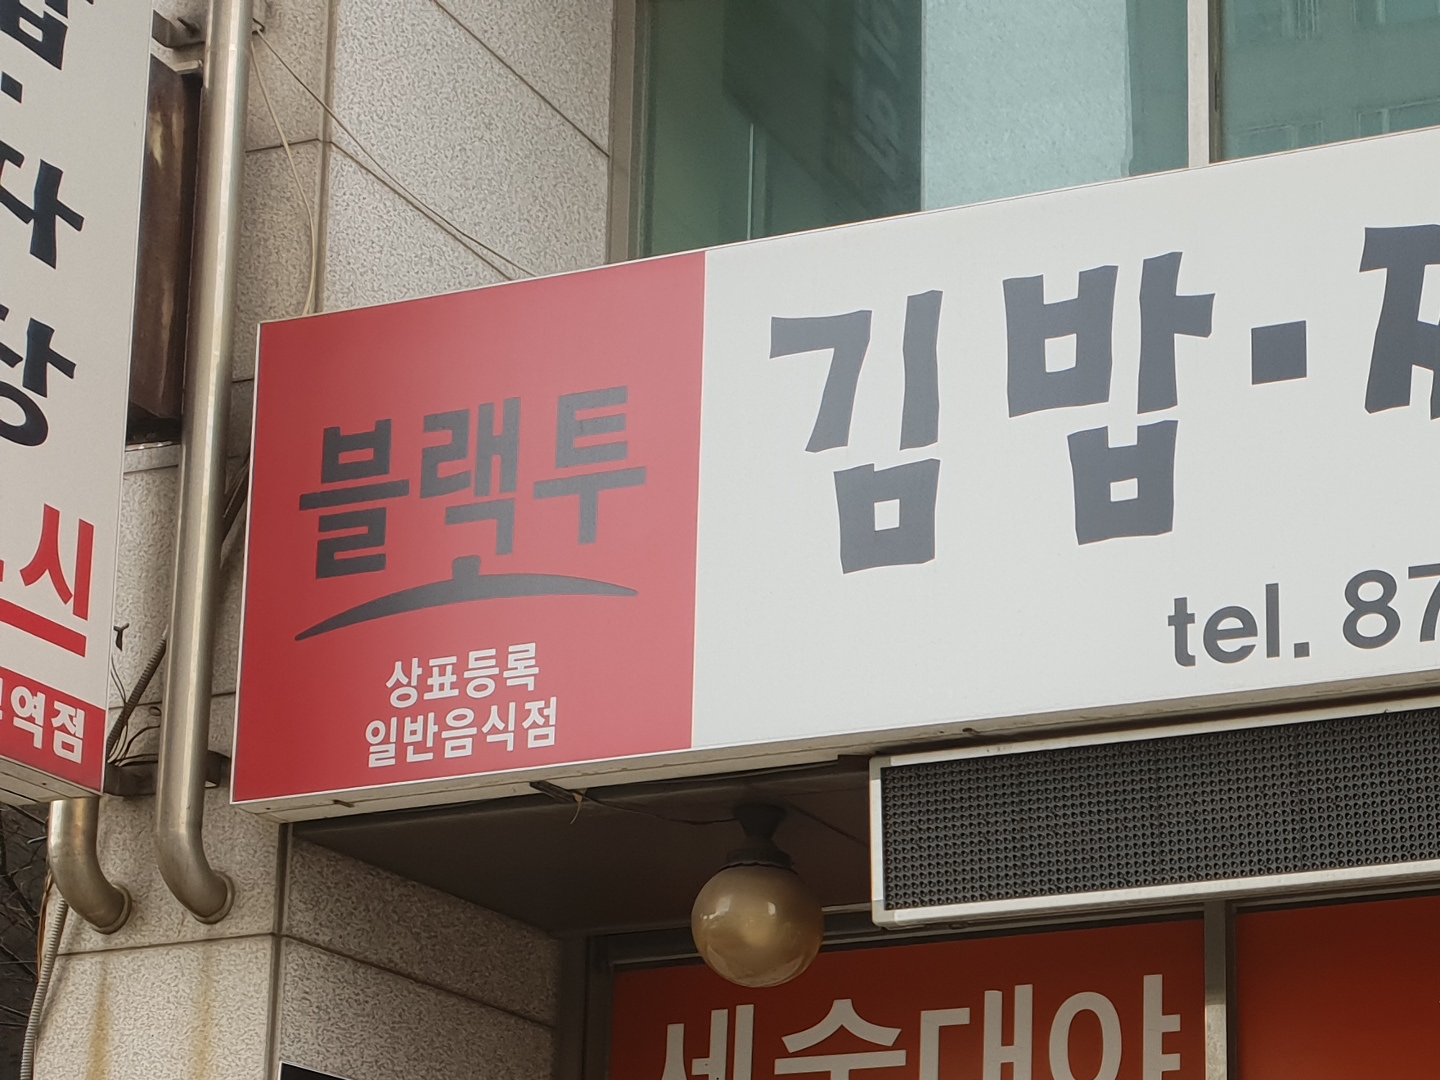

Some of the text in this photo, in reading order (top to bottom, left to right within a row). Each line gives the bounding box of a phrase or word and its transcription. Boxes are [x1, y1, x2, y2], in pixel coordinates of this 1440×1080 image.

[299, 385, 647, 580] 블랙투
[1167, 582, 1310, 667] tel.
[385, 641, 540, 707] 상표등록
[0, 677, 85, 764] 역점
[364, 696, 558, 768] 일반음식점
